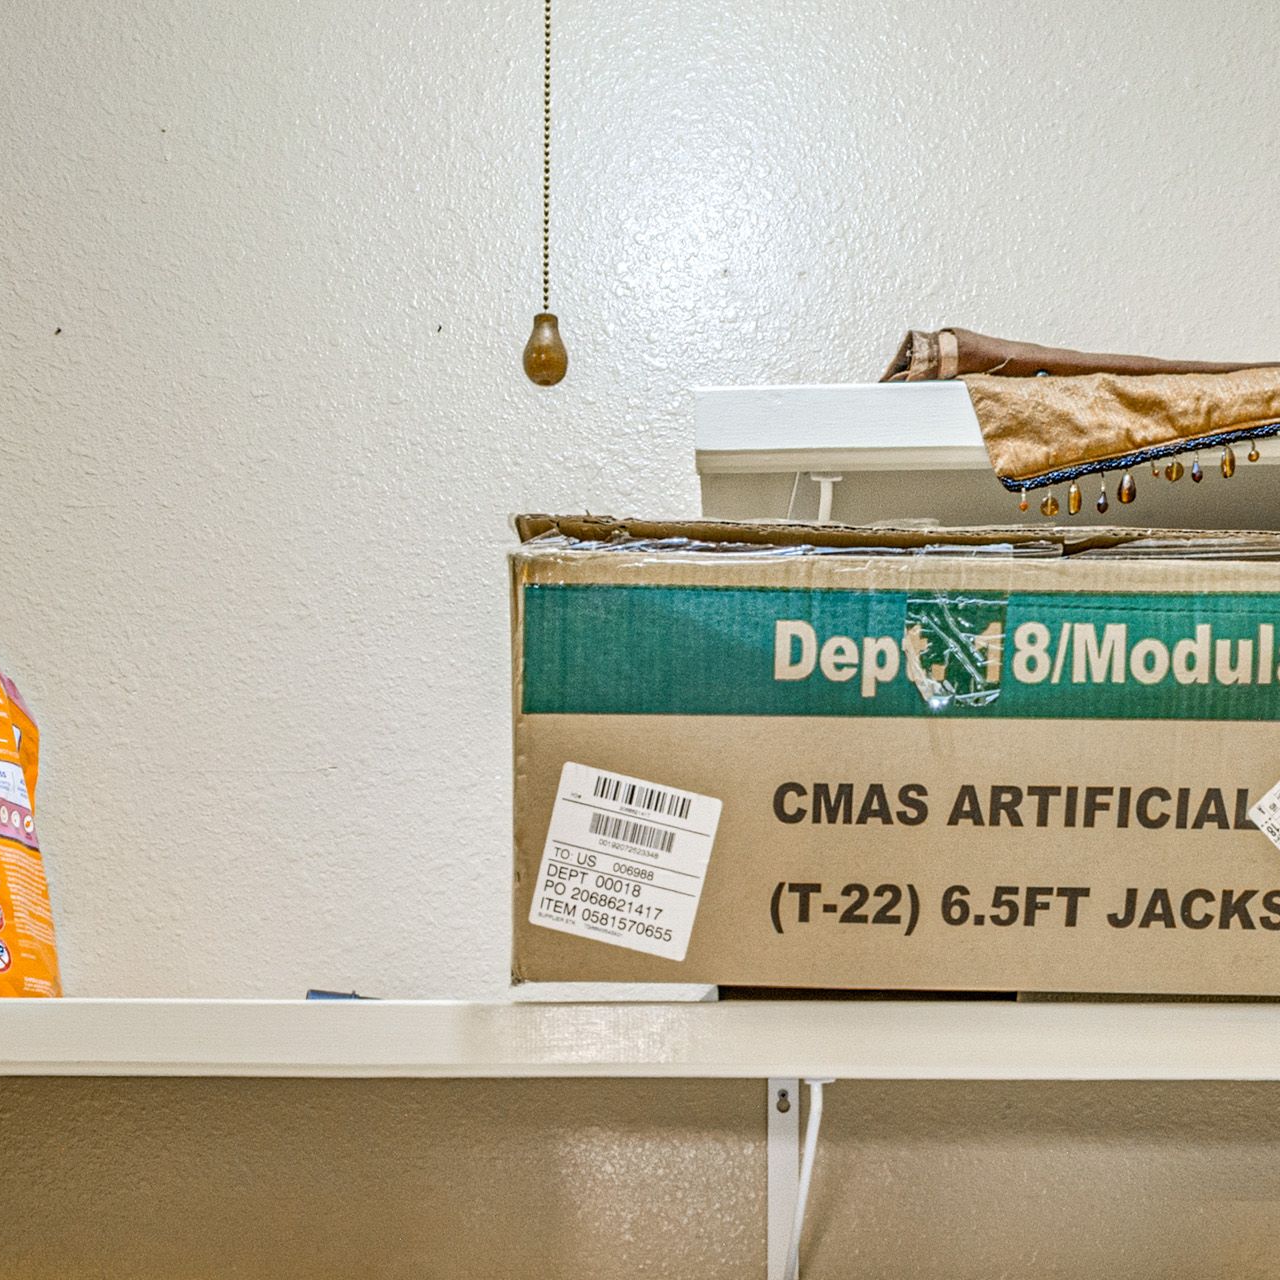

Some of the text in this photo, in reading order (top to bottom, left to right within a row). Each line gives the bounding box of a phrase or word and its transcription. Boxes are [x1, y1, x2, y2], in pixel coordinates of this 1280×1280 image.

[773, 782, 928, 826] CMAS
[946, 786, 1261, 831] ARTIFICIAL
[546, 863, 642, 898] DEPT 00018
[576, 852, 598, 868] US
[613, 862, 655, 882] 006988
[540, 897, 578, 918] ITEM
[581, 908, 673, 943] 0581570655
[543, 880, 664, 921] PO 2068621417
[770, 882, 922, 936] (T-22)
[940, 885, 1090, 928] 6.5FT
